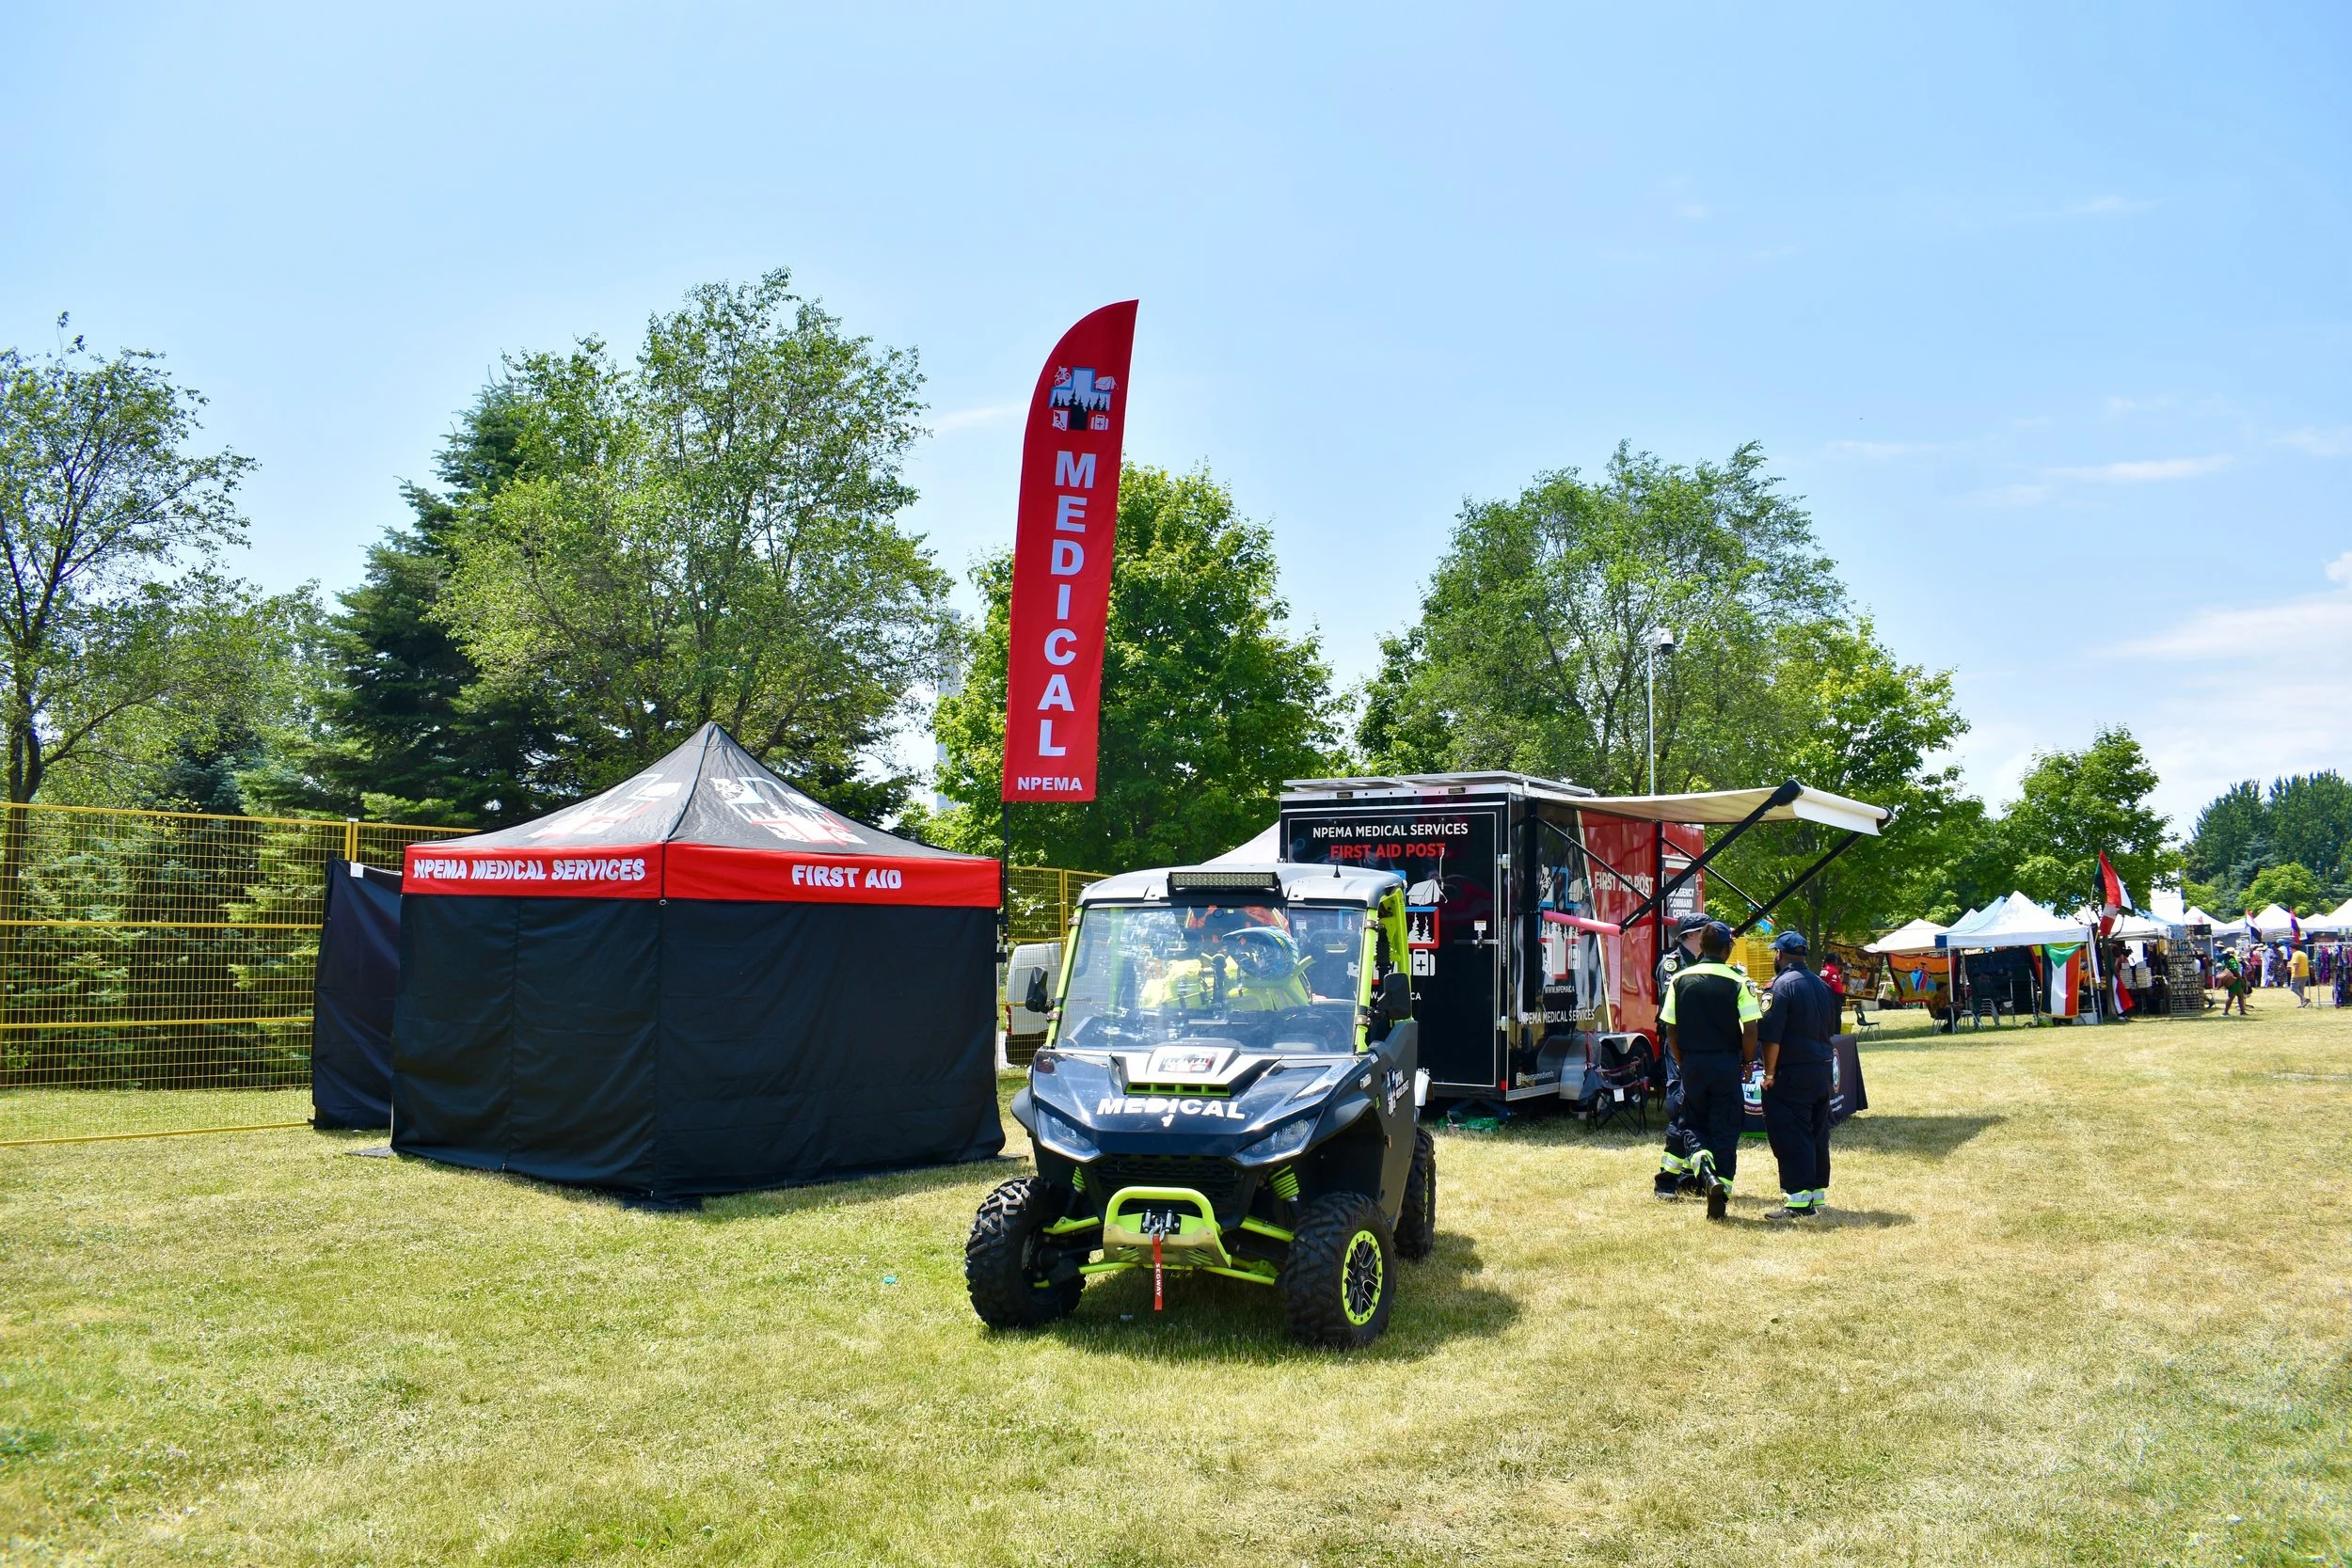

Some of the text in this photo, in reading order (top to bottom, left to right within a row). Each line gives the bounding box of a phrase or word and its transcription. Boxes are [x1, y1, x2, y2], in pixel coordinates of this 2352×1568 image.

[1037, 451, 1096, 757] MEDICAL
[1017, 777, 1083, 791] NPEMA
[1312, 823, 1469, 838] NPEMA MEDICAL SERVICES
[1330, 843, 1446, 859] FIRST AID POST
[413, 858, 645, 881] NPEMA MEDICAL SERVICES
[791, 864, 902, 889] FIRST AID
[1595, 871, 1617, 891] FIRST
[1634, 875, 1654, 894] POST
[1520, 1008, 1595, 1024] NPEMA MEDICAL SERVICES
[1096, 1098, 1246, 1120] MEDICAL
